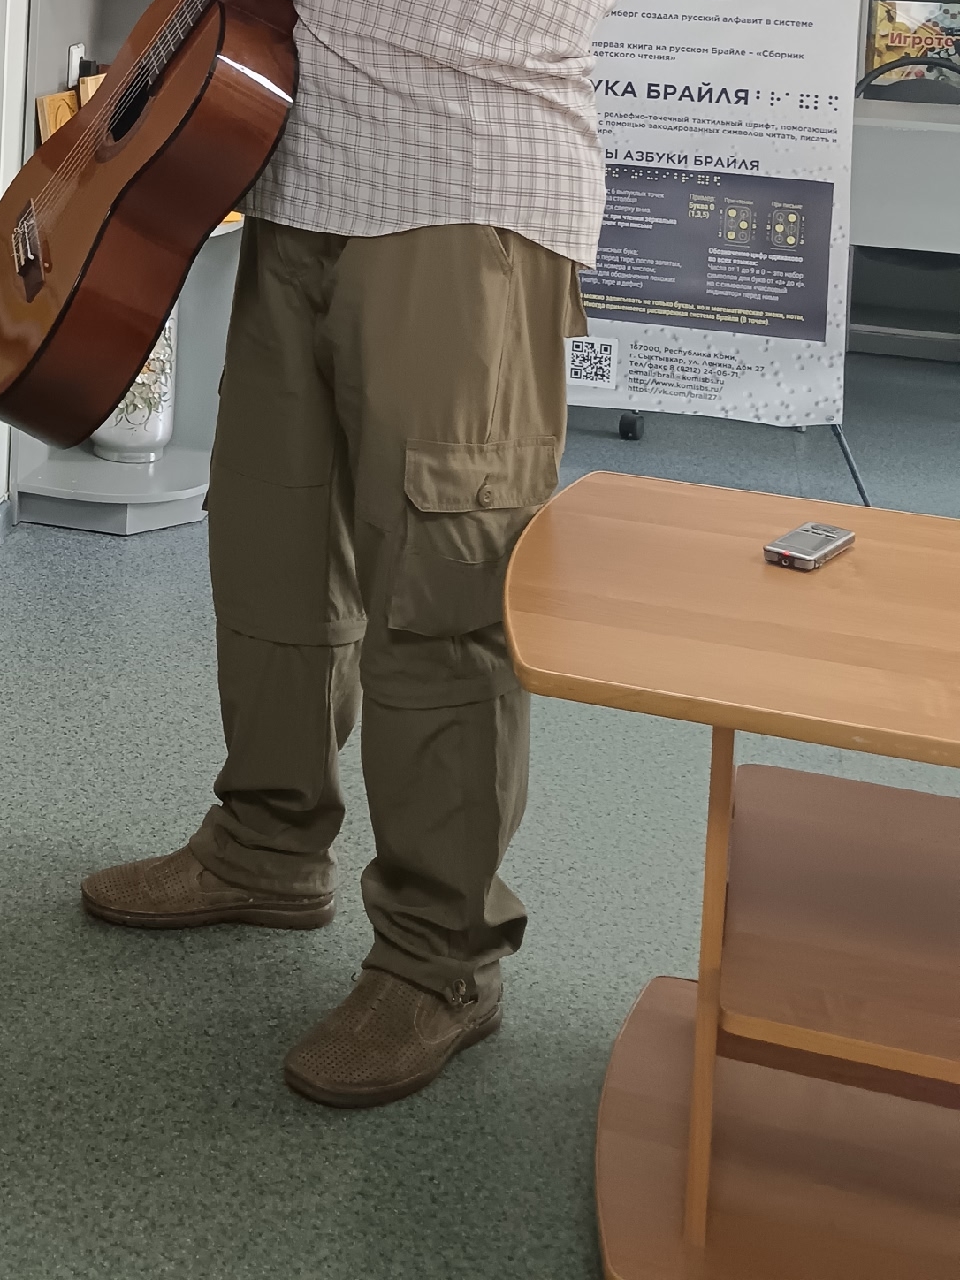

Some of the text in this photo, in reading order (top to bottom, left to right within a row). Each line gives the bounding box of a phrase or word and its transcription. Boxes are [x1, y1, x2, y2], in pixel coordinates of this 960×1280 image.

[641, 12, 678, 20] создала
[682, 13, 720, 22] русский
[774, 19, 813, 27] системе
[889, 32, 955, 48] Игроте
[627, 43, 653, 51] книга
[711, 47, 746, 56] Брайле
[590, 79, 750, 105] УКА БРАЙЛЯ
[623, 150, 688, 165] АЗБУКИ
[694, 155, 760, 171] БРАЙЛЯ
